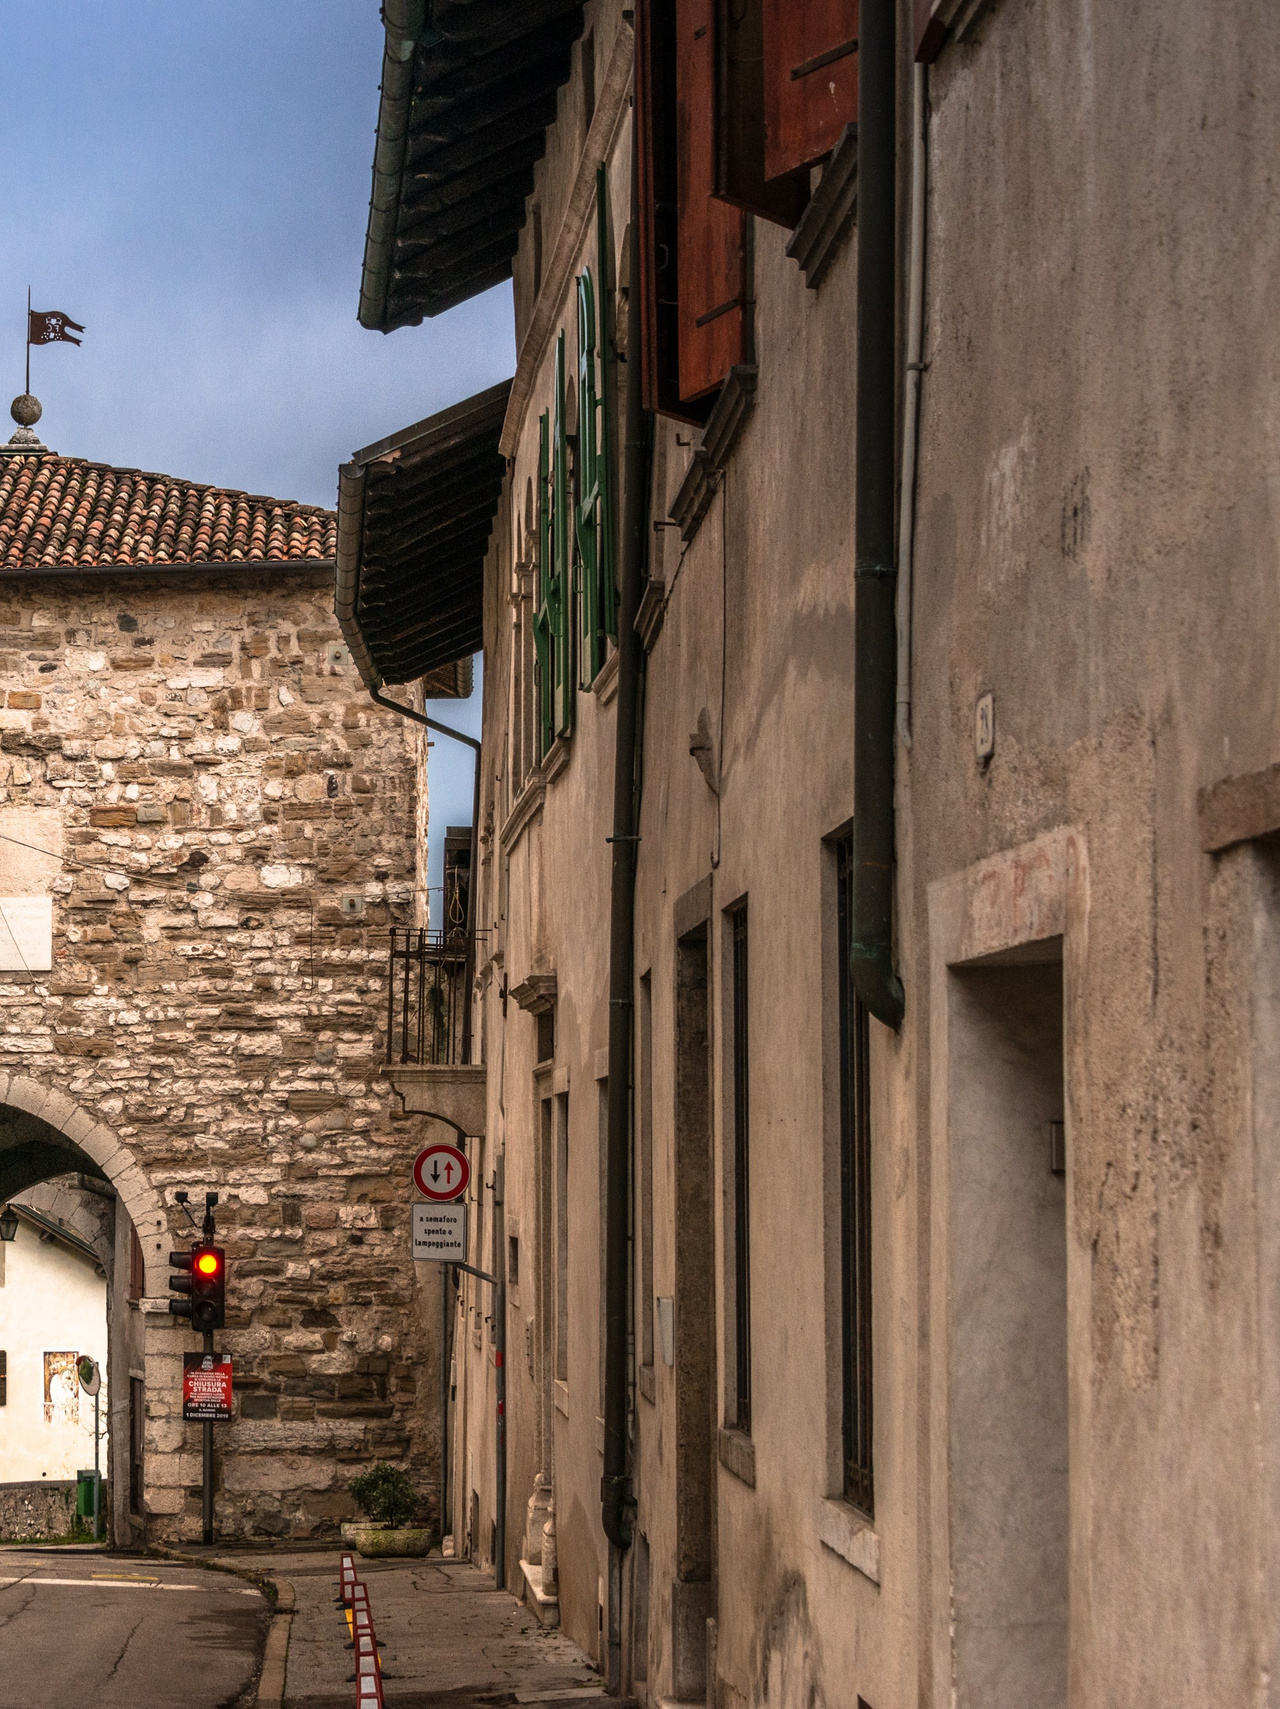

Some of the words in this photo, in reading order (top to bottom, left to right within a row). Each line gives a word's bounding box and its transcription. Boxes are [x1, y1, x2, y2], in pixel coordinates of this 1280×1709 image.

[425, 1215, 457, 1223] semaforo
[424, 1227, 447, 1236] spento
[415, 1238, 461, 1248] lampeggiante
